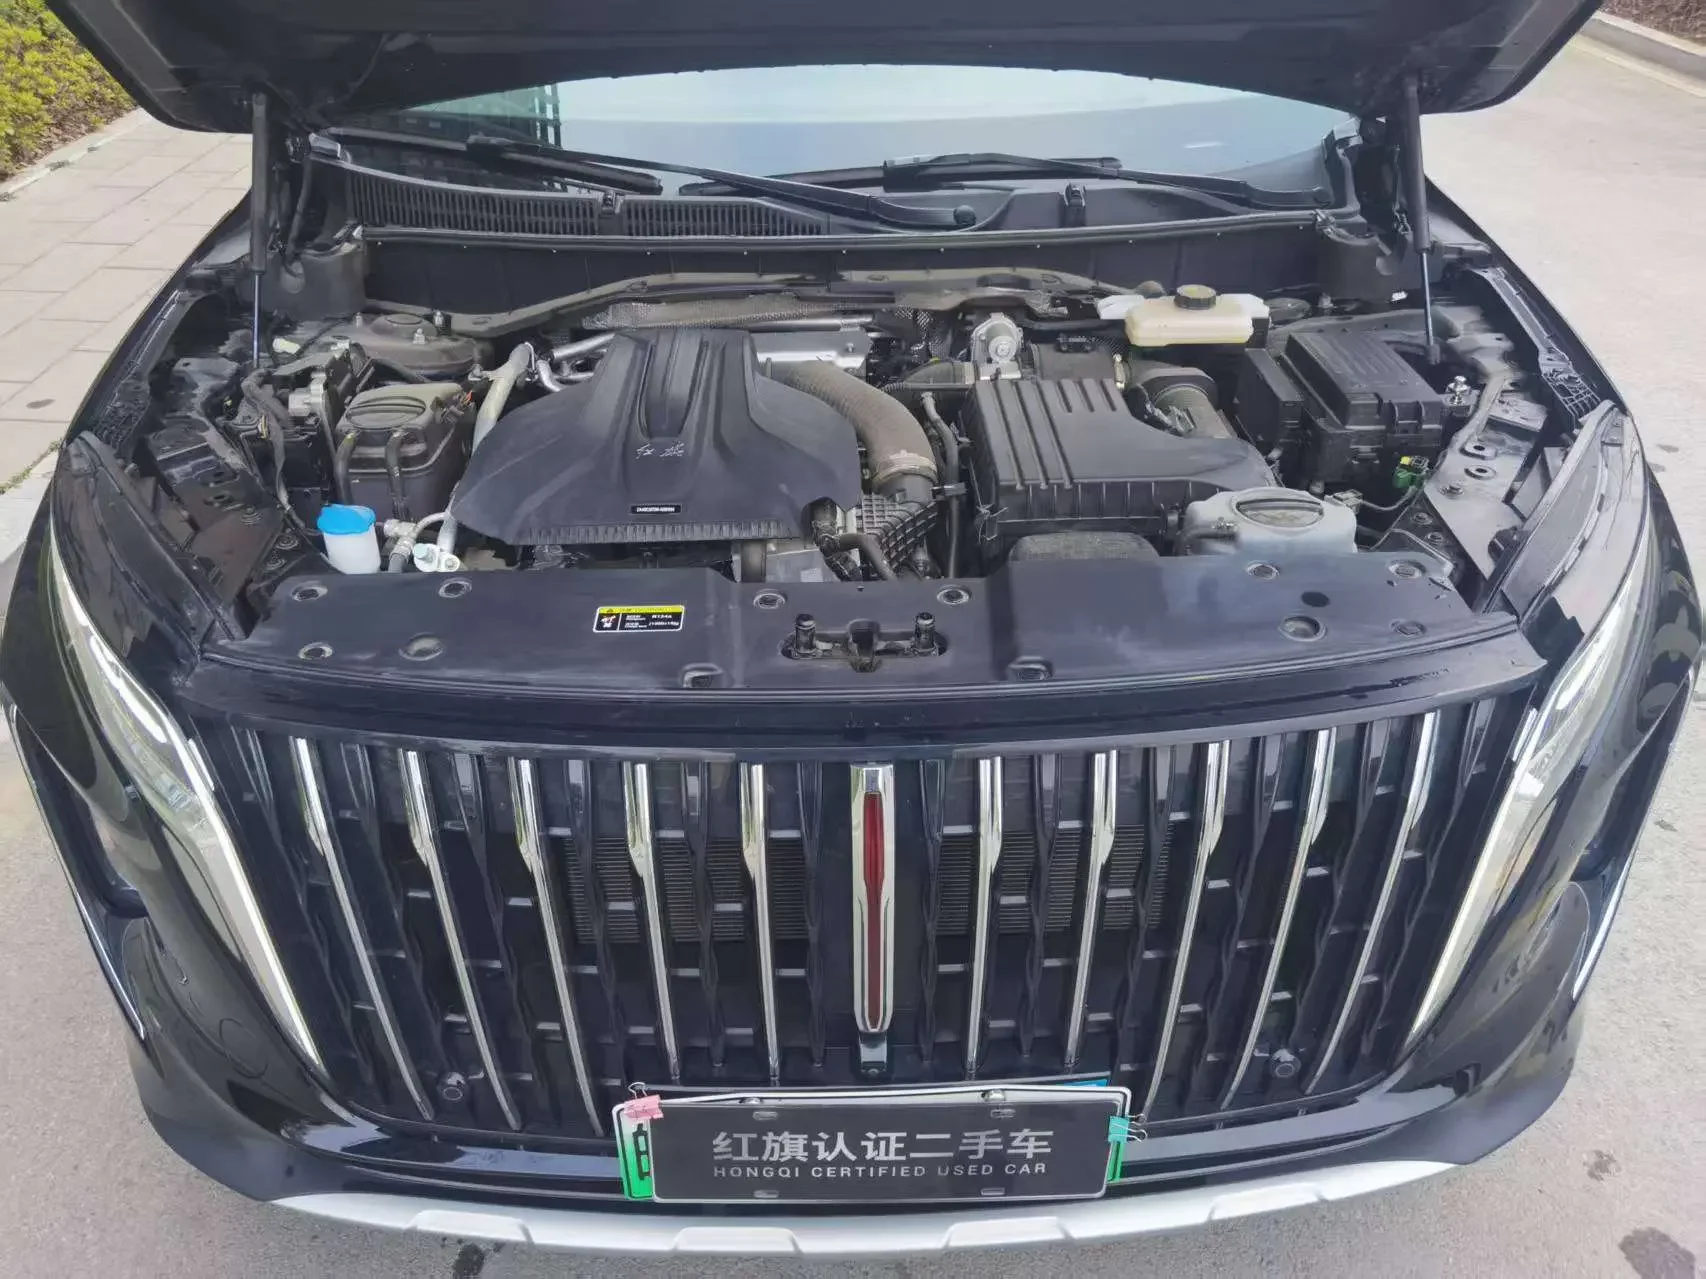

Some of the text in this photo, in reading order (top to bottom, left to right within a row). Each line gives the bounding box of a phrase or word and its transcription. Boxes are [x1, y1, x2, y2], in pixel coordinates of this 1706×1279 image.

[712, 1128, 1054, 1162] 红旗认证二手车
[713, 1163, 1046, 1178] HONGQI CERTIFIED USED CAR
